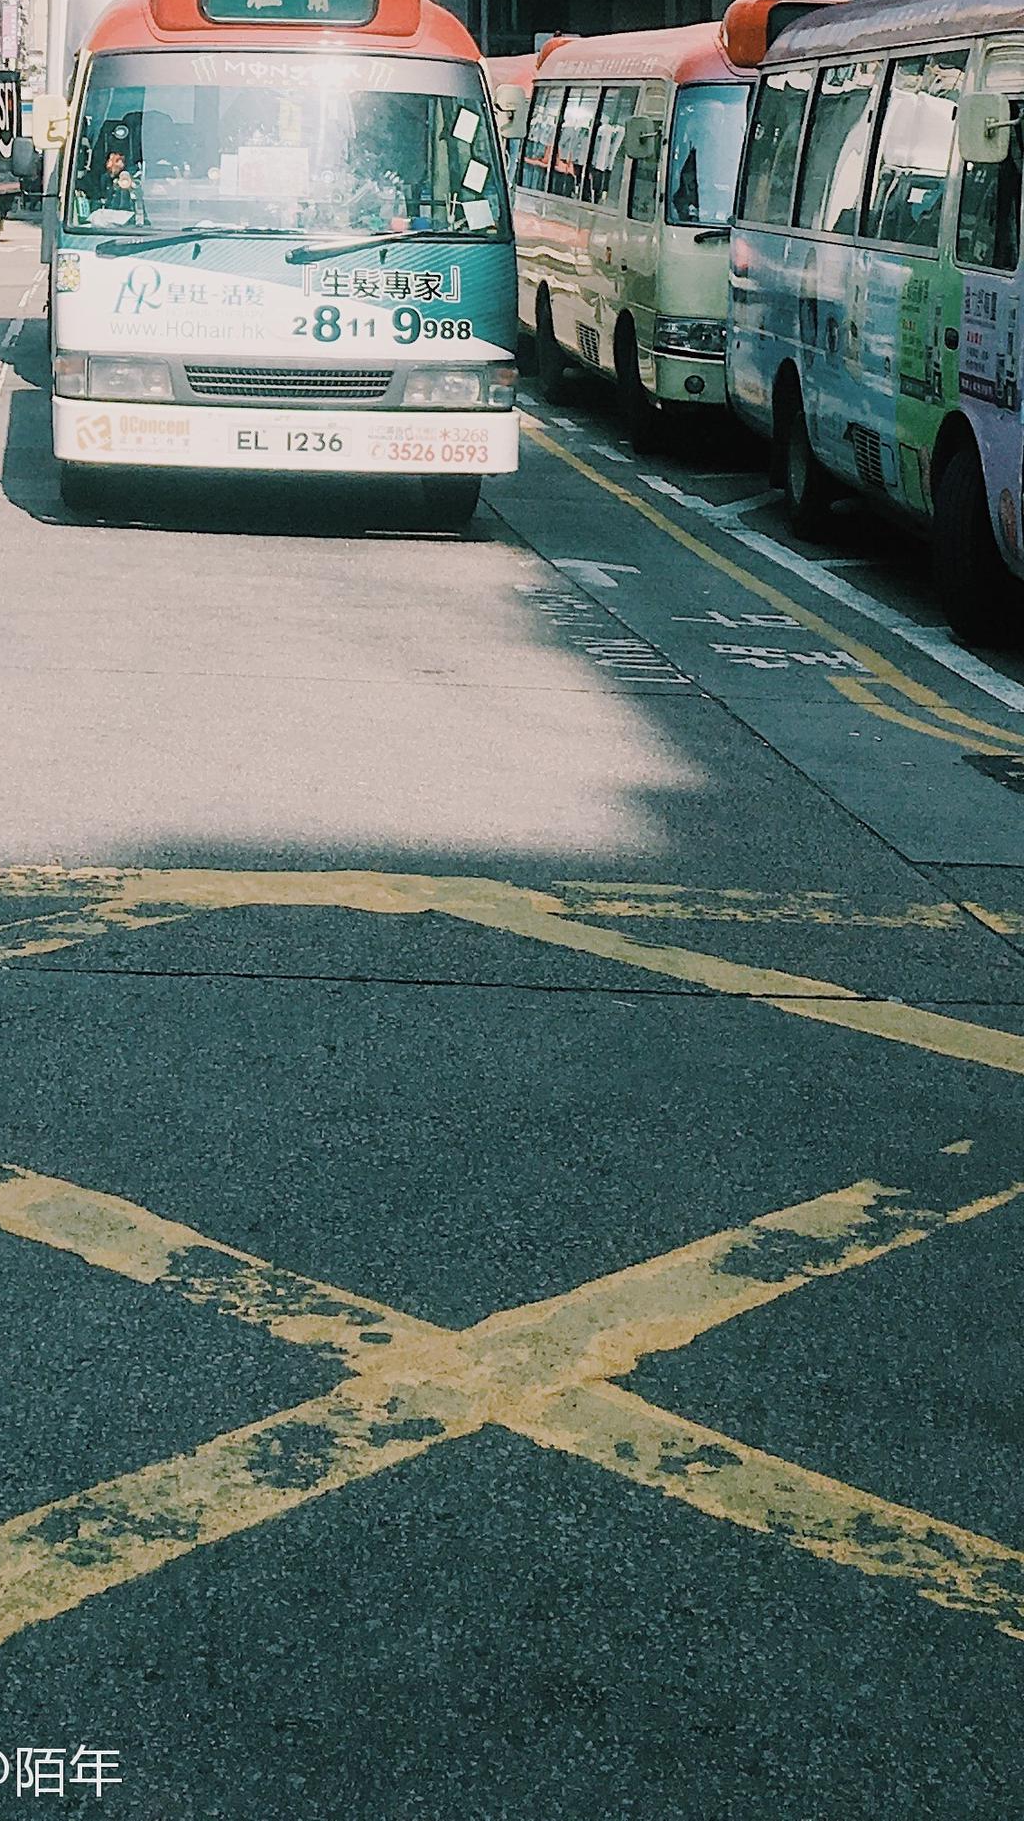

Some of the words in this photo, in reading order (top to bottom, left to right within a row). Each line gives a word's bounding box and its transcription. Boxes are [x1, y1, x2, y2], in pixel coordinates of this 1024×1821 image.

[392, 307, 472, 345] 9988
[236, 430, 269, 451] EL
[286, 432, 344, 452] 1236
[387, 443, 436, 462] 3526
[440, 445, 489, 464] 0593
